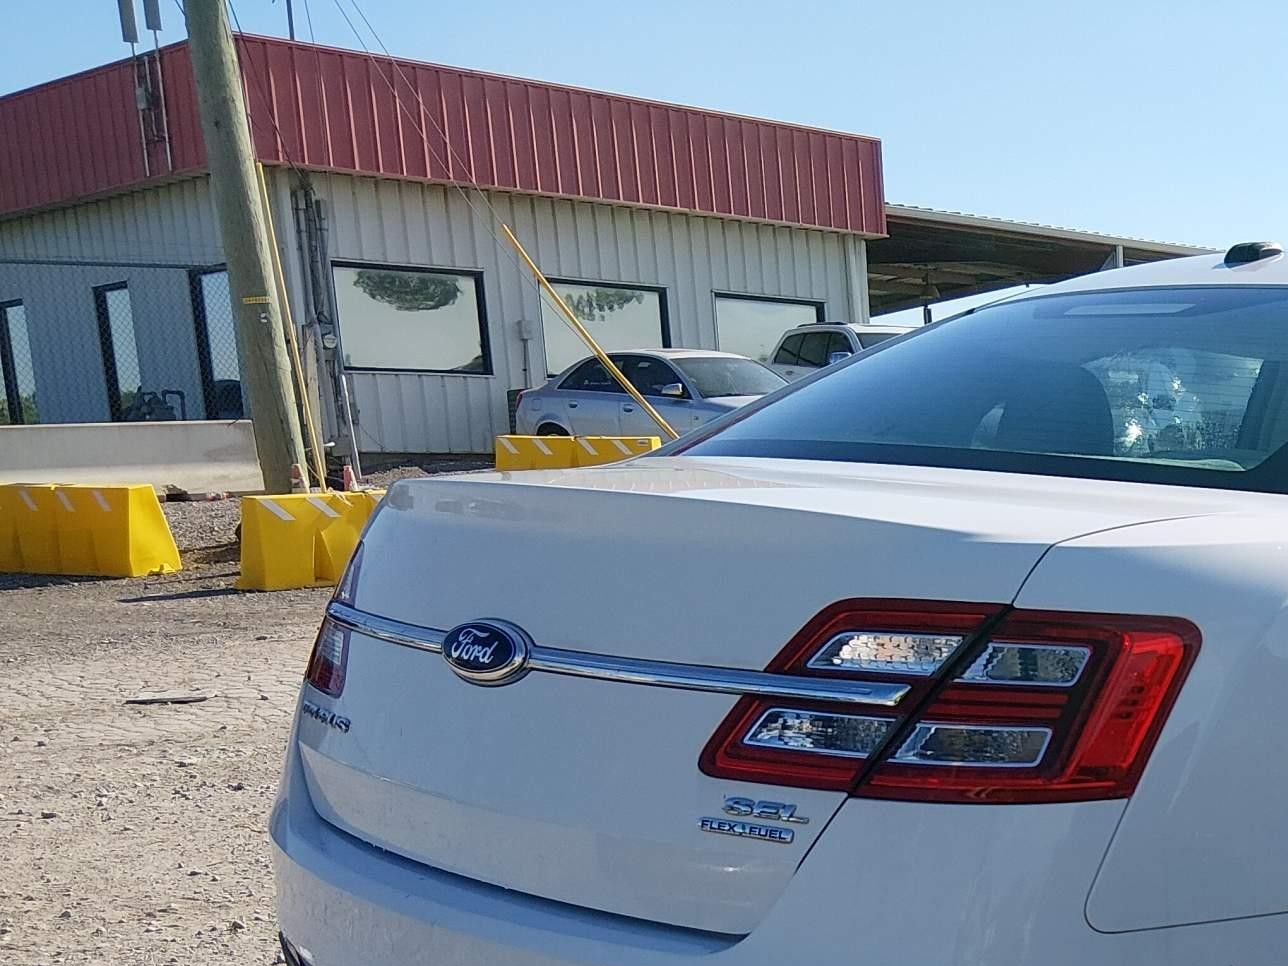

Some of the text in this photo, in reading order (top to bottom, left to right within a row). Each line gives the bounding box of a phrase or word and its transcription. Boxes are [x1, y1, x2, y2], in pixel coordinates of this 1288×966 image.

[451, 628, 499, 664] Ford
[723, 798, 810, 823] SEL
[700, 819, 788, 840] FLEX FUEL
